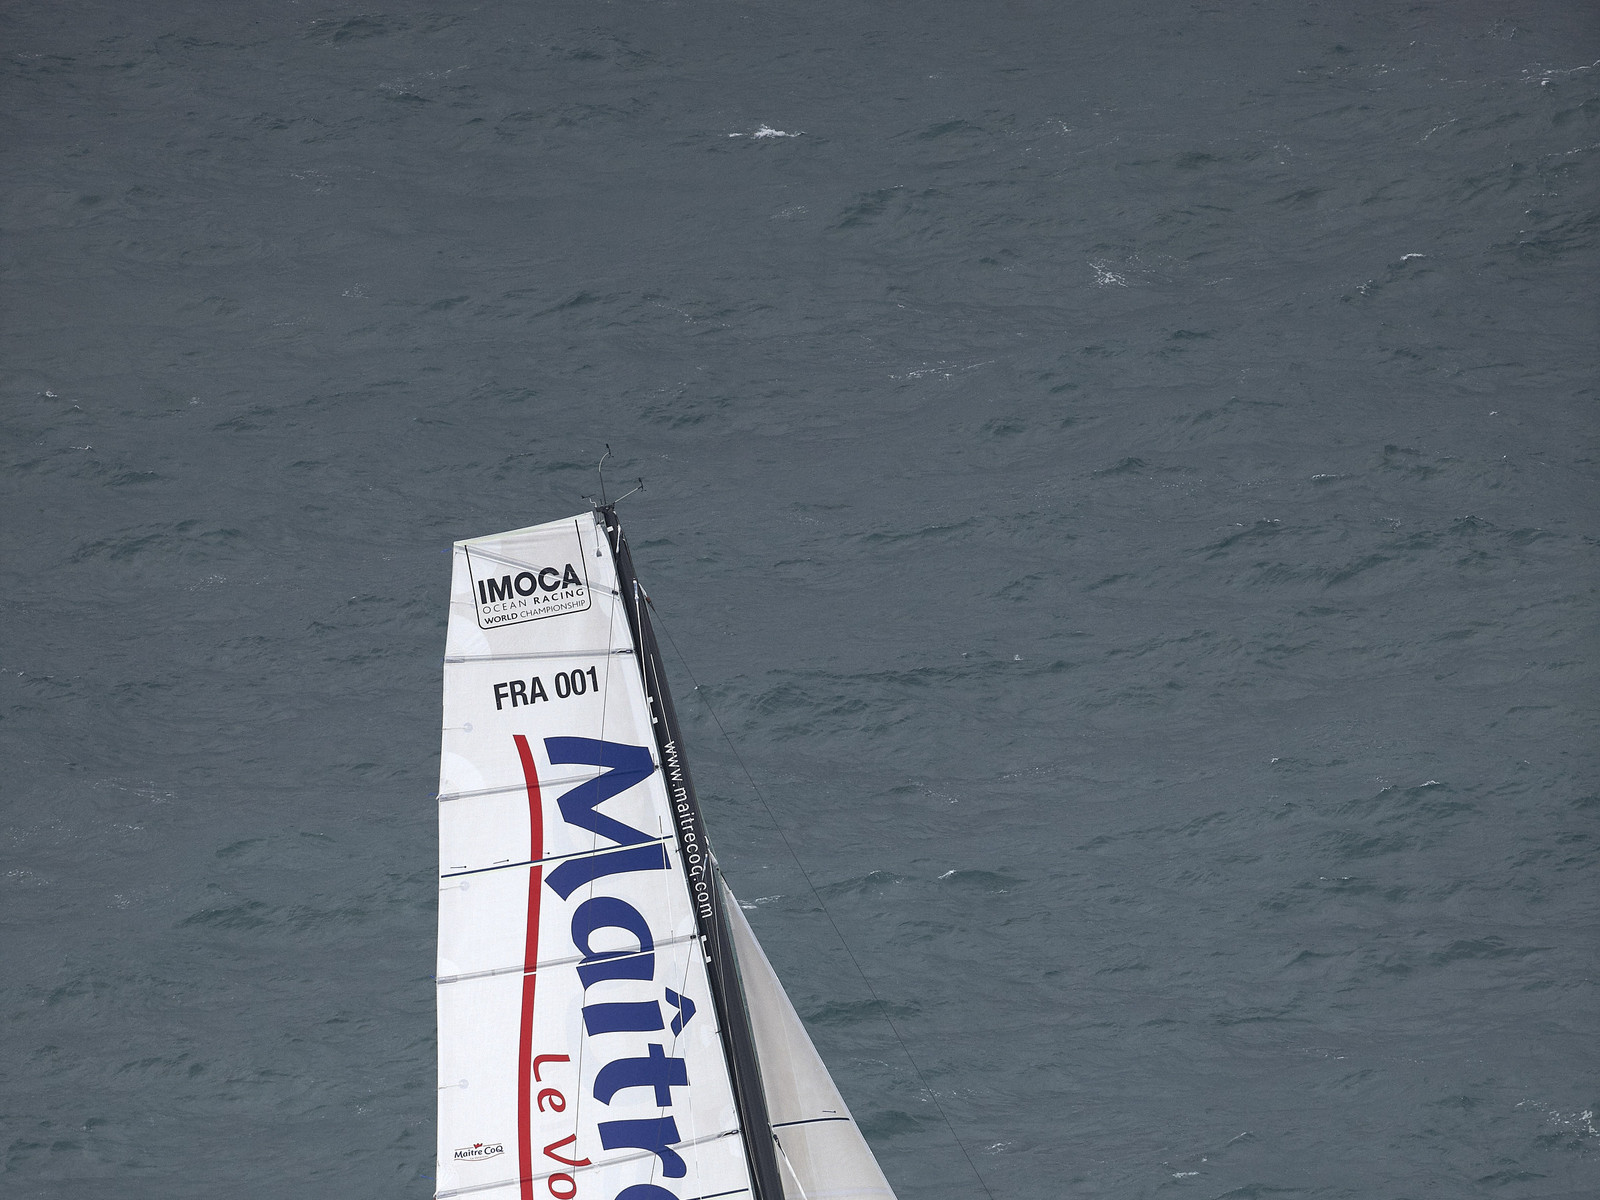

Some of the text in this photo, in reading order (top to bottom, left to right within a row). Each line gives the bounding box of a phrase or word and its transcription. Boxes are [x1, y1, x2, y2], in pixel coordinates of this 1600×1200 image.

[478, 563, 582, 604] IMOCA
[482, 588, 584, 614] OCEAN RACING
[484, 600, 586, 625] WORLD CHAMPIONSHIP
[493, 666, 599, 711] FRA 001
[664, 740, 714, 919] www.maitrecoq.com
[532, 1054, 571, 1113] Le
[484, 1145, 504, 1155] CoQ
